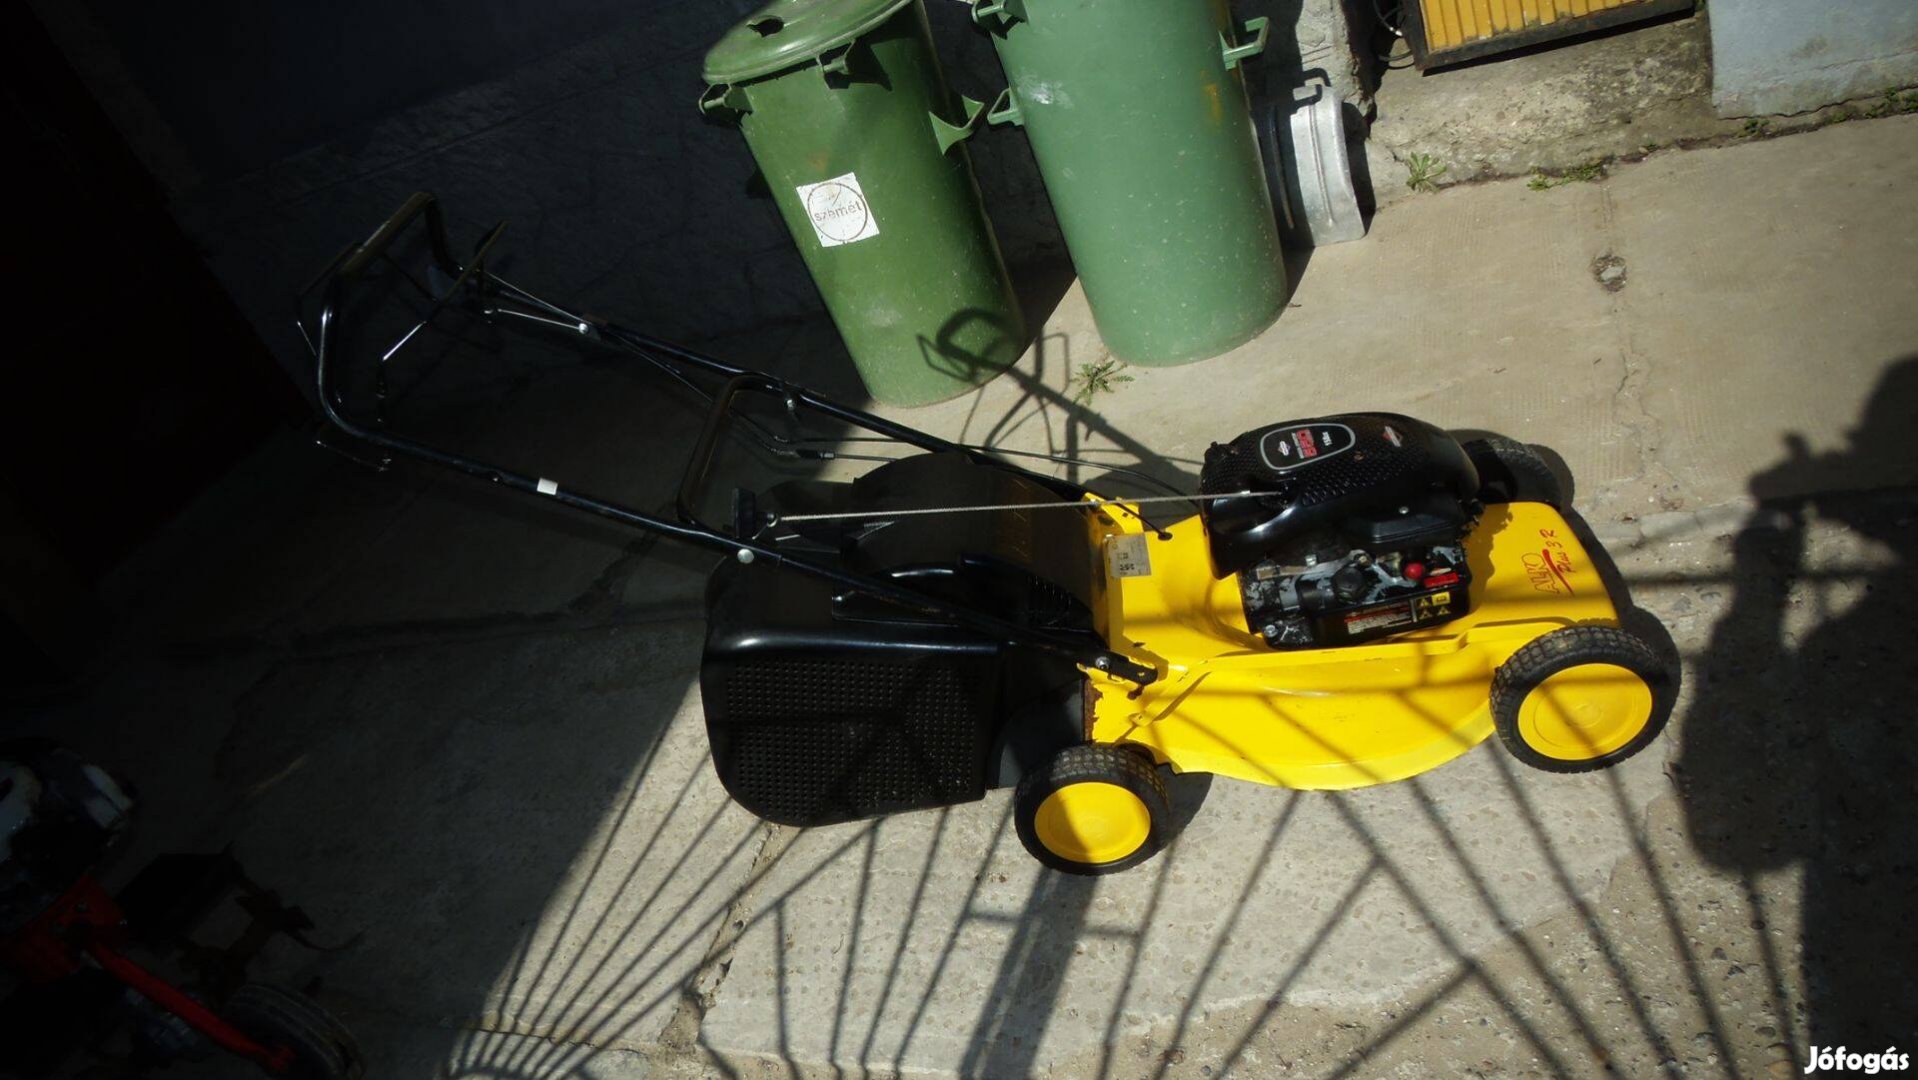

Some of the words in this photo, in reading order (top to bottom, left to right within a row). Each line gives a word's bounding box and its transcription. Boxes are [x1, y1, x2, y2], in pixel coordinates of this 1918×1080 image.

[815, 200, 862, 222] szemét
[1539, 528, 1558, 538] R
[1545, 540, 1563, 548] 3
